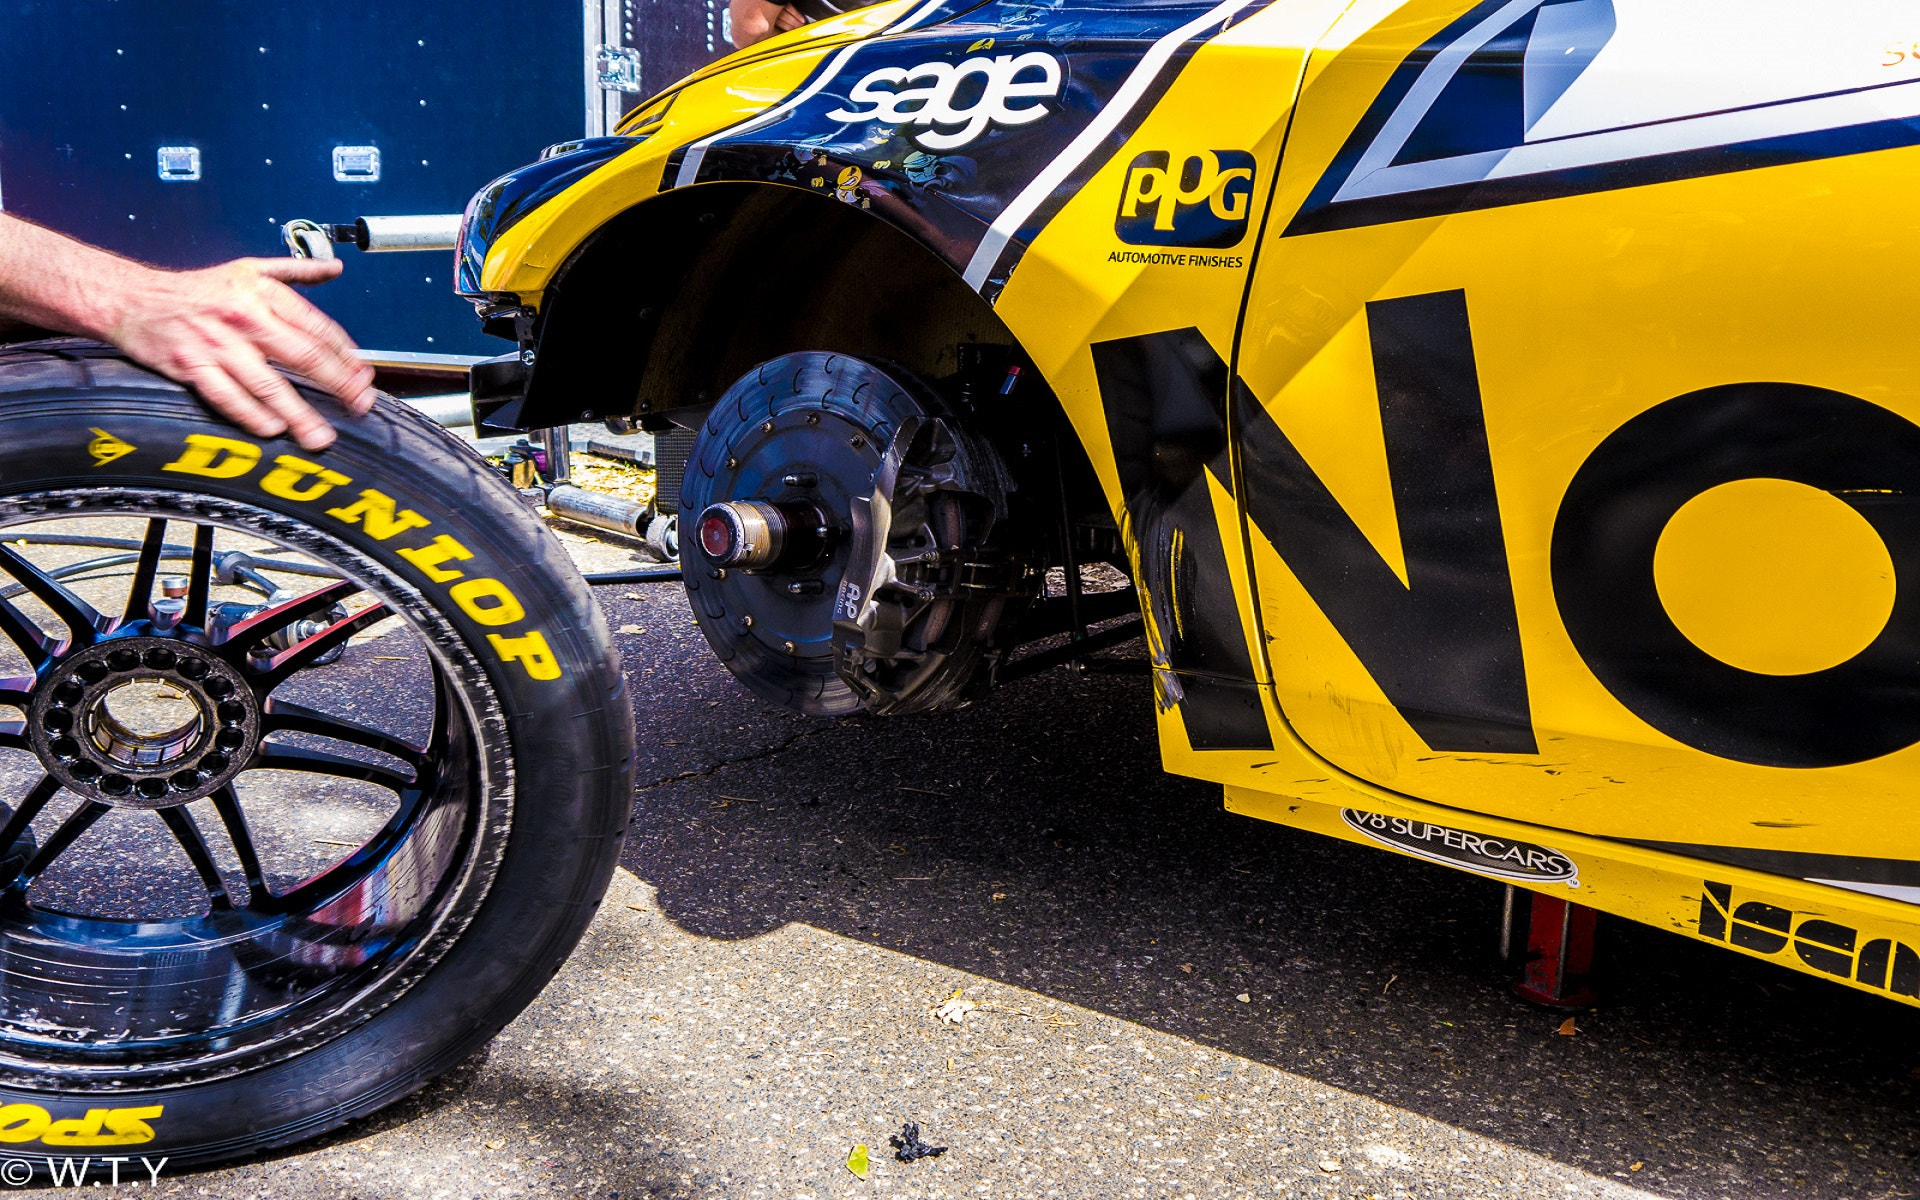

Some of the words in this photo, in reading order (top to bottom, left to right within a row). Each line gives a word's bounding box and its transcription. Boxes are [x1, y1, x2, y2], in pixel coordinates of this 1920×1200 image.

[825, 51, 1061, 149] sage
[1108, 252, 1186, 266] AUTOMOTIVE
[1188, 255, 1243, 268] FINISHES
[162, 434, 562, 681] DUNLOP
[1090, 288, 1920, 768] NO
[1352, 809, 1387, 829] V8
[1391, 818, 1567, 874] SUPERCARS
